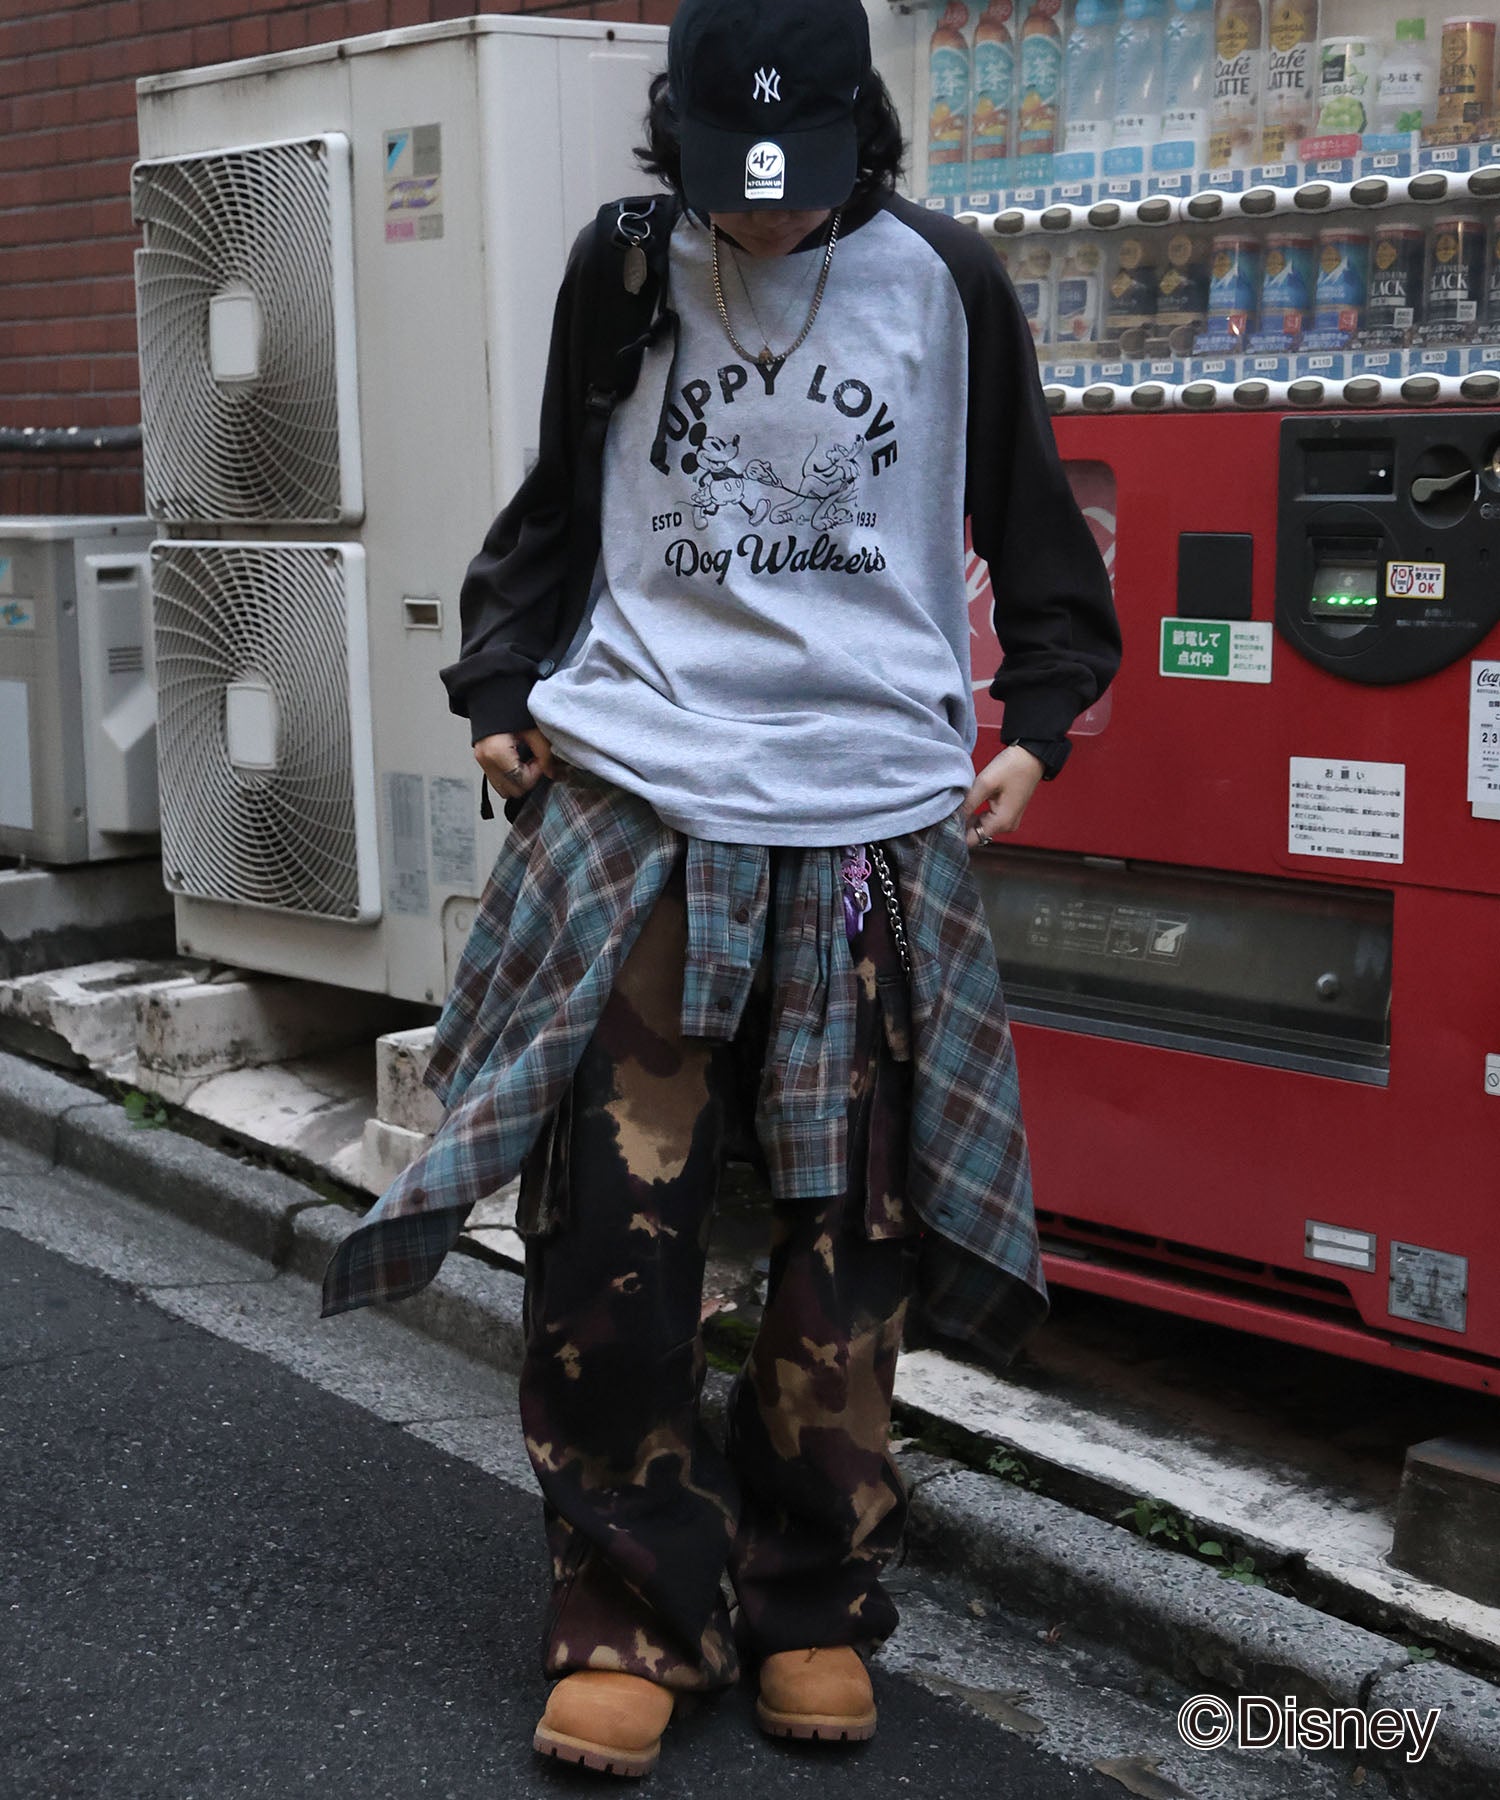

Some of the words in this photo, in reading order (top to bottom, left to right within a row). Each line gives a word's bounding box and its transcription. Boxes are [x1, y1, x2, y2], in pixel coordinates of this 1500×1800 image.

[752, 67, 781, 103] NY
[806, 364, 898, 477] LOVE
[652, 511, 682, 532] ESTD
[856, 512, 877, 528] 1933
[664, 539, 733, 585] Dog
[1418, 582, 1435, 594] OK
[1172, 630, 1221, 648] 節電して
[1177, 651, 1214, 668] 点灯中
